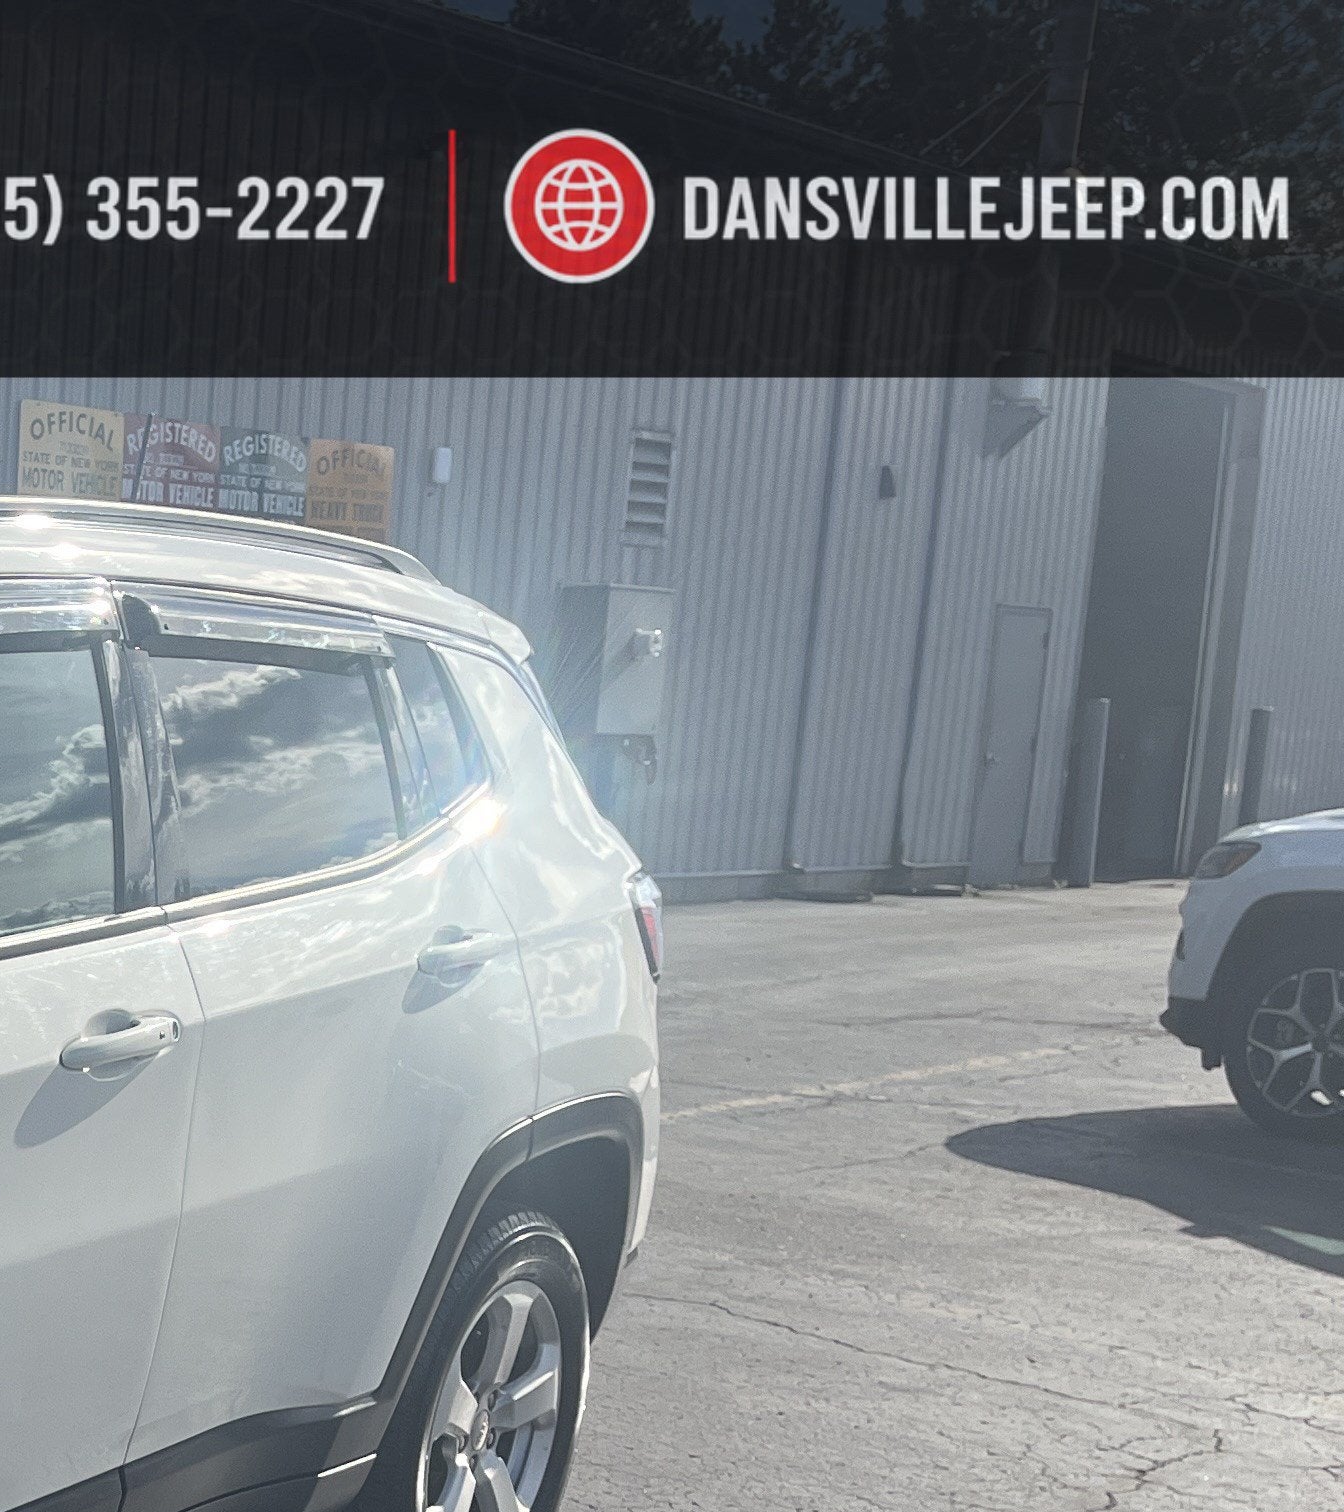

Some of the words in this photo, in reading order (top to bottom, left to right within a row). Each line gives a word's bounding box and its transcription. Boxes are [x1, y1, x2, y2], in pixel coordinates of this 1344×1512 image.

[30, 410, 114, 451] OFFICIAL
[126, 421, 216, 463] REGISTERED
[22, 451, 51, 465] STATE
[55, 454, 67, 466] OF
[71, 456, 91, 469] NEW
[222, 433, 307, 473] REGISTERED
[21, 466, 65, 492] MOTOR
[71, 472, 119, 496] VEHICLE
[123, 463, 152, 477] STTE
[170, 468, 189, 481] NEW
[121, 478, 164, 502] MTOR
[169, 483, 215, 508] VEHICLE
[218, 488, 259, 513] MOTOR
